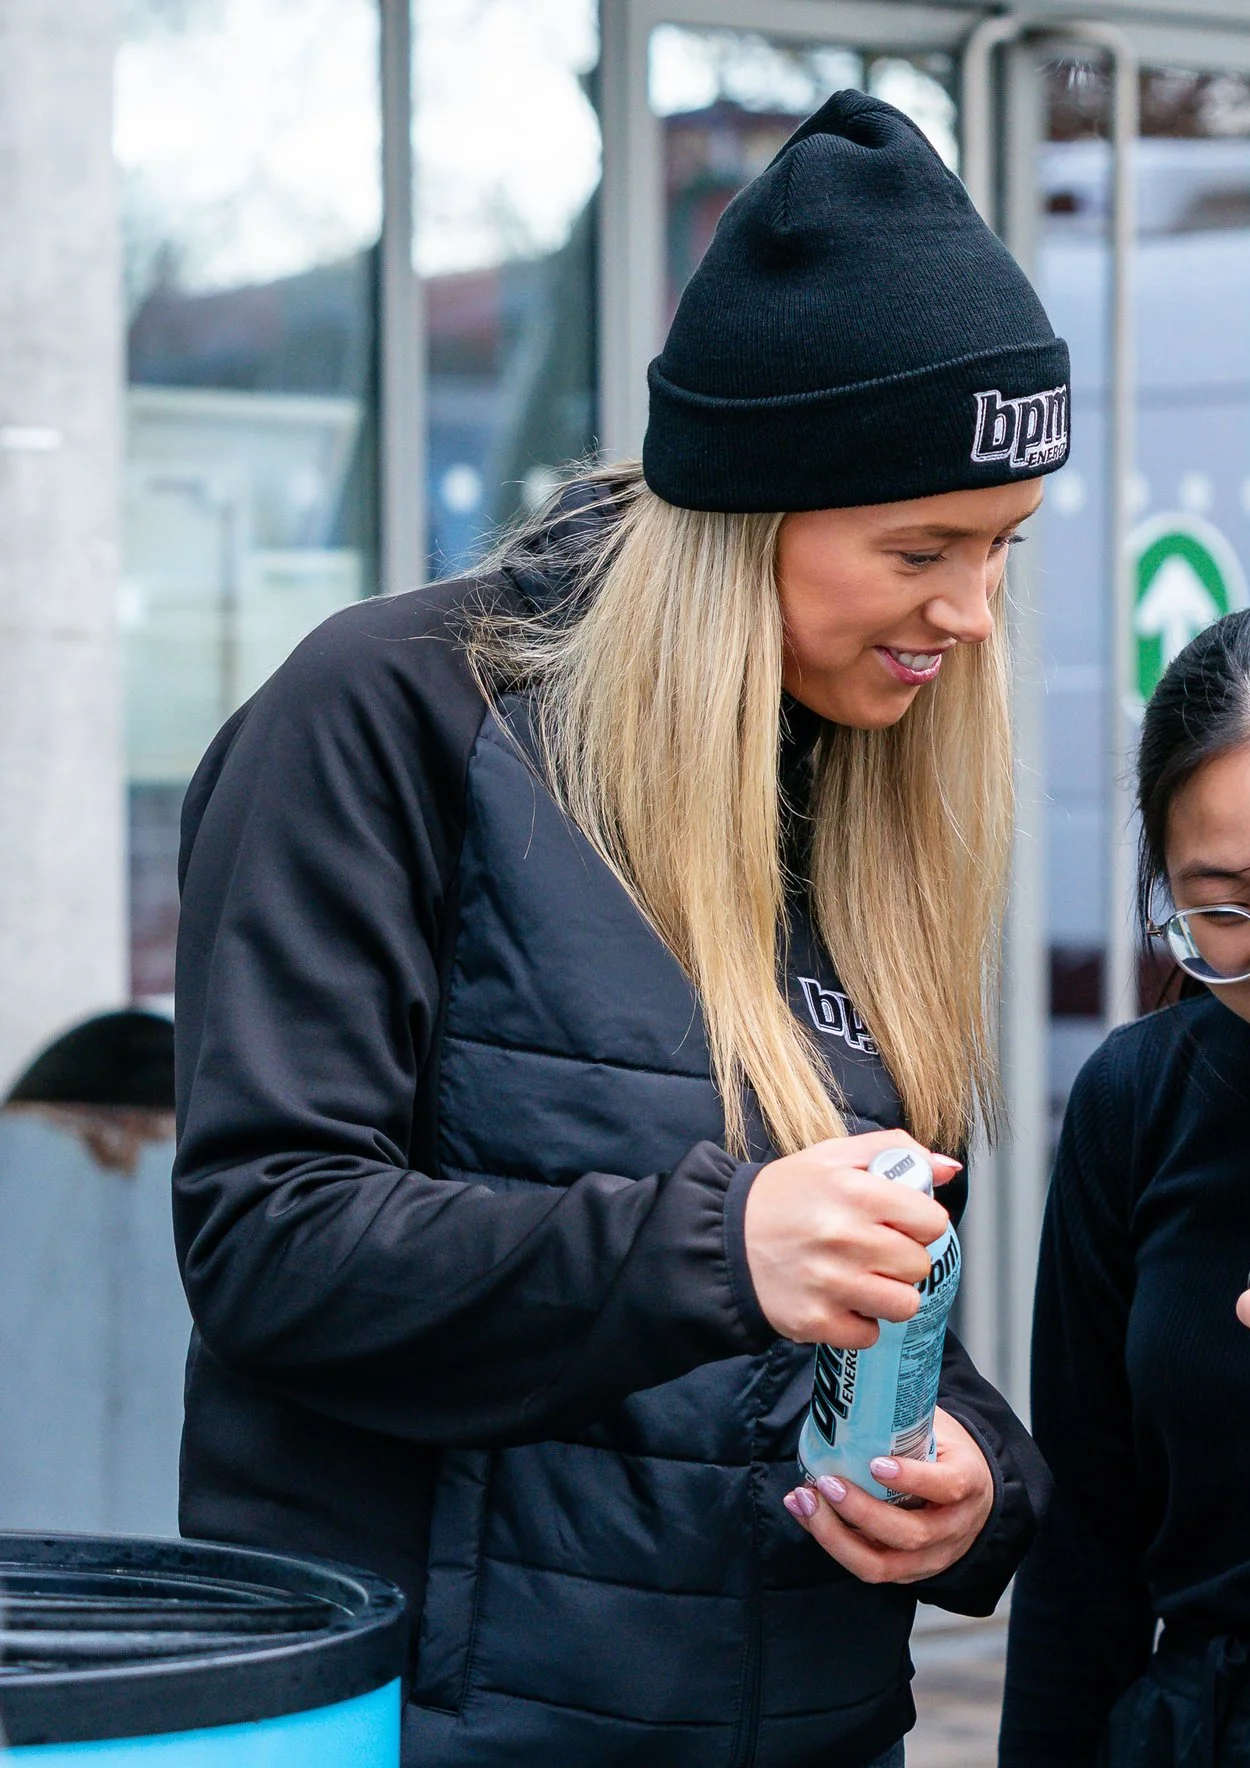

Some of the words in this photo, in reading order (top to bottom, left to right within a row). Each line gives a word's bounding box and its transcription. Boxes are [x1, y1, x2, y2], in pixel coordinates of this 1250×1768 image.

[1027, 443, 1066, 466] ENERG
[797, 976, 872, 1050] bp
[883, 1154, 916, 1180] bpm
[917, 1235, 959, 1297] pm
[842, 1349, 858, 1404] ENERG
